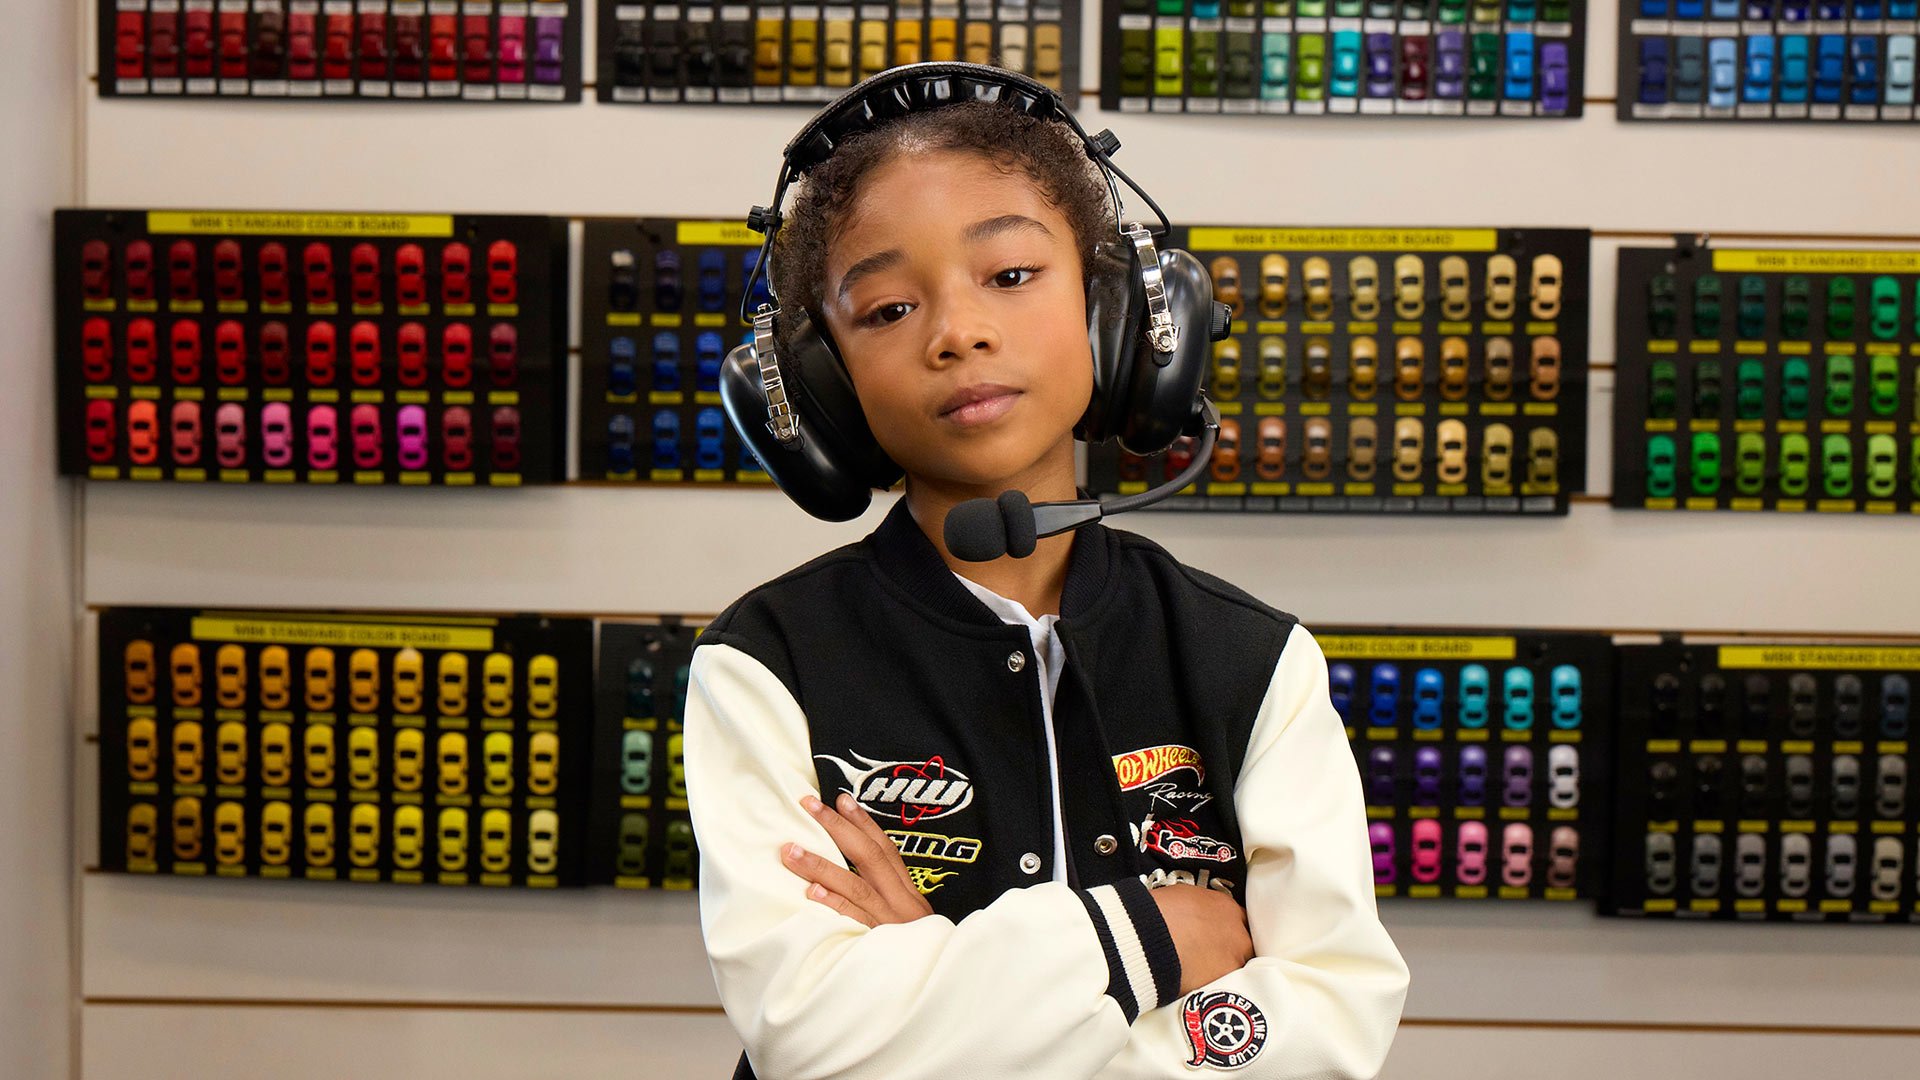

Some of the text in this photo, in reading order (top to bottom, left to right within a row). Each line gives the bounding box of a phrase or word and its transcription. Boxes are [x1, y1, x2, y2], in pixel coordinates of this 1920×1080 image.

[226, 217, 305, 230] STANDARD
[306, 219, 355, 231] COLOR
[357, 219, 410, 231] BOARD
[1269, 233, 1348, 245] STANDARD
[1351, 234, 1400, 246] COLOR
[1402, 234, 1455, 246] BOARD
[1871, 256, 1917, 267] COLOR
[270, 626, 346, 639] STANDARD
[349, 629, 397, 641] COLOR
[400, 630, 451, 643] BOARD
[1369, 640, 1418, 653] COLOR
[1421, 641, 1472, 653] BOARD
[1879, 653, 1920, 665] COLO
[860, 777, 969, 806] HW
[1143, 783, 1213, 812] Racing
[1227, 994, 1266, 1066] RED LINE CLUB
